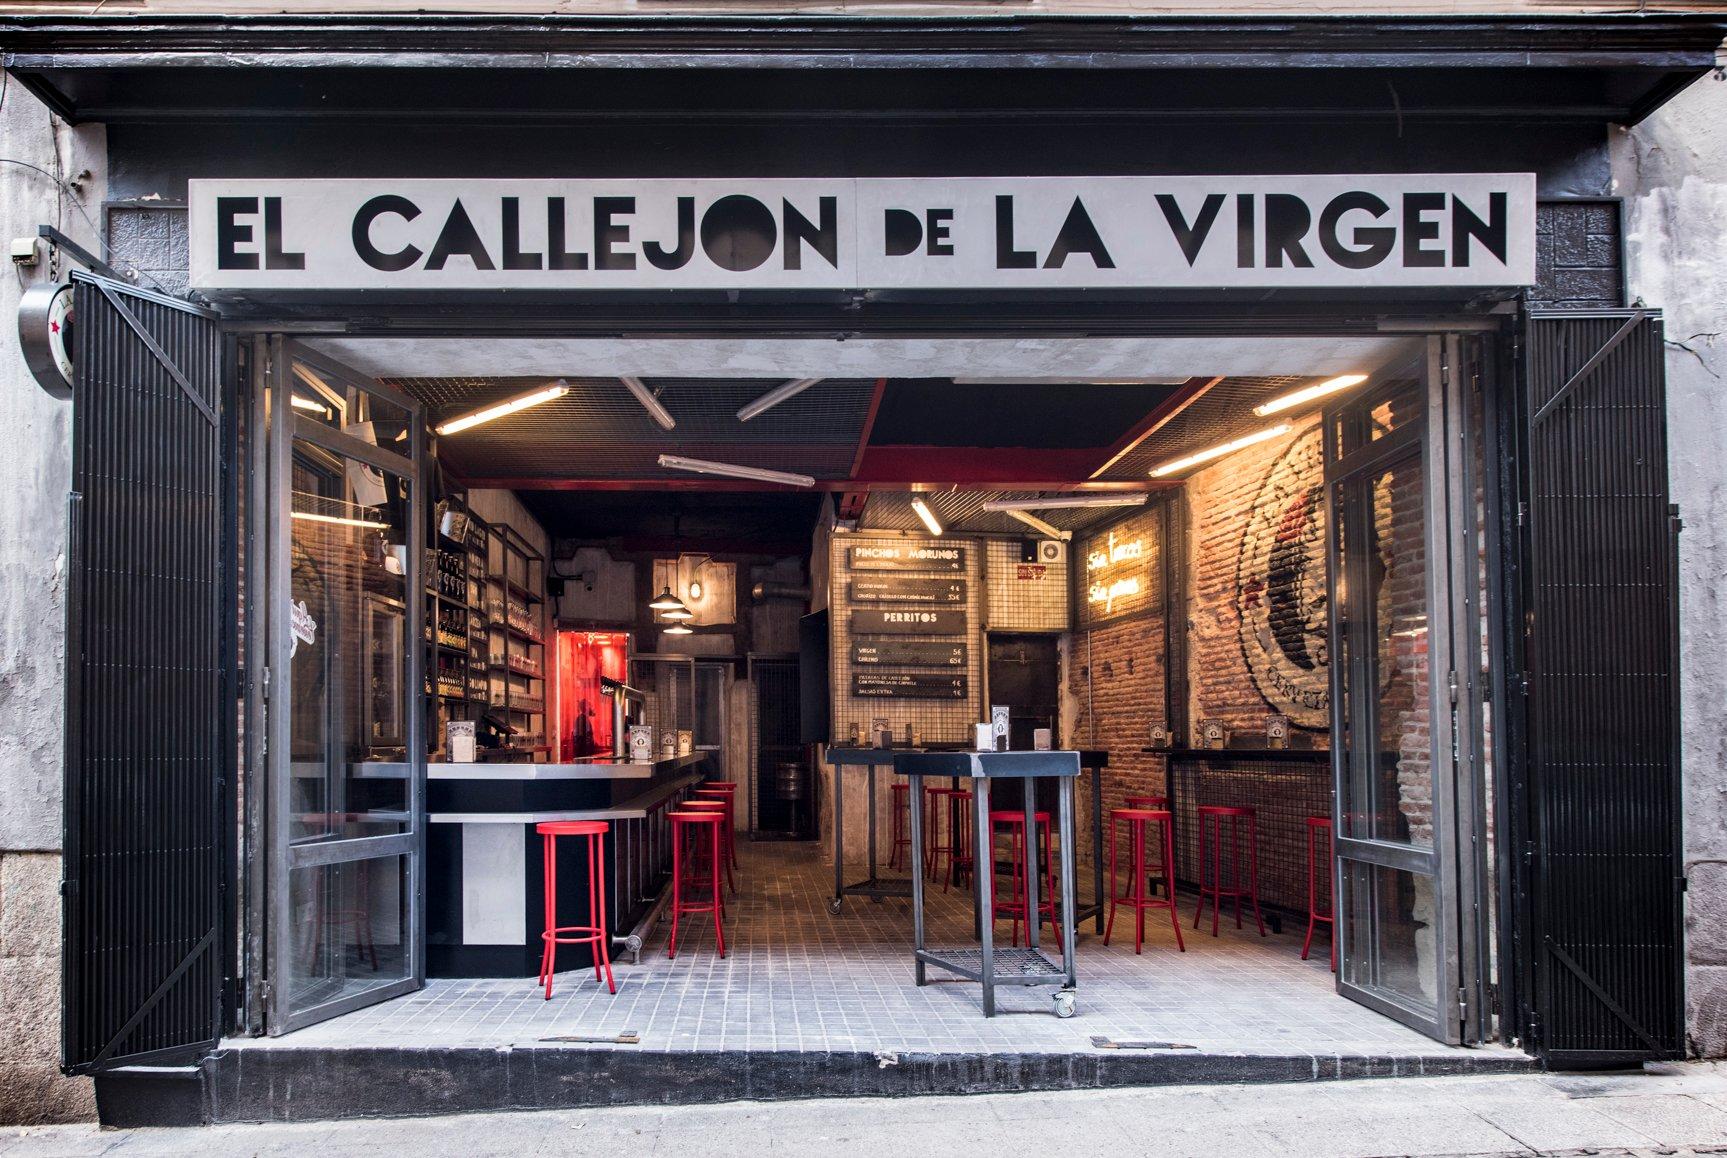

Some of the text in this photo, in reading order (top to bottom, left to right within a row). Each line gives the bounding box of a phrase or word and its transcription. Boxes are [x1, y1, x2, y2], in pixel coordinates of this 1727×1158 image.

[217, 190, 1508, 272] EL CALLEJON DE LA VIRGEN
[855, 547, 959, 560] PINCHOS MORUNOS
[883, 612, 938, 623] PERRITOS
[952, 648, 962, 656] 5€
